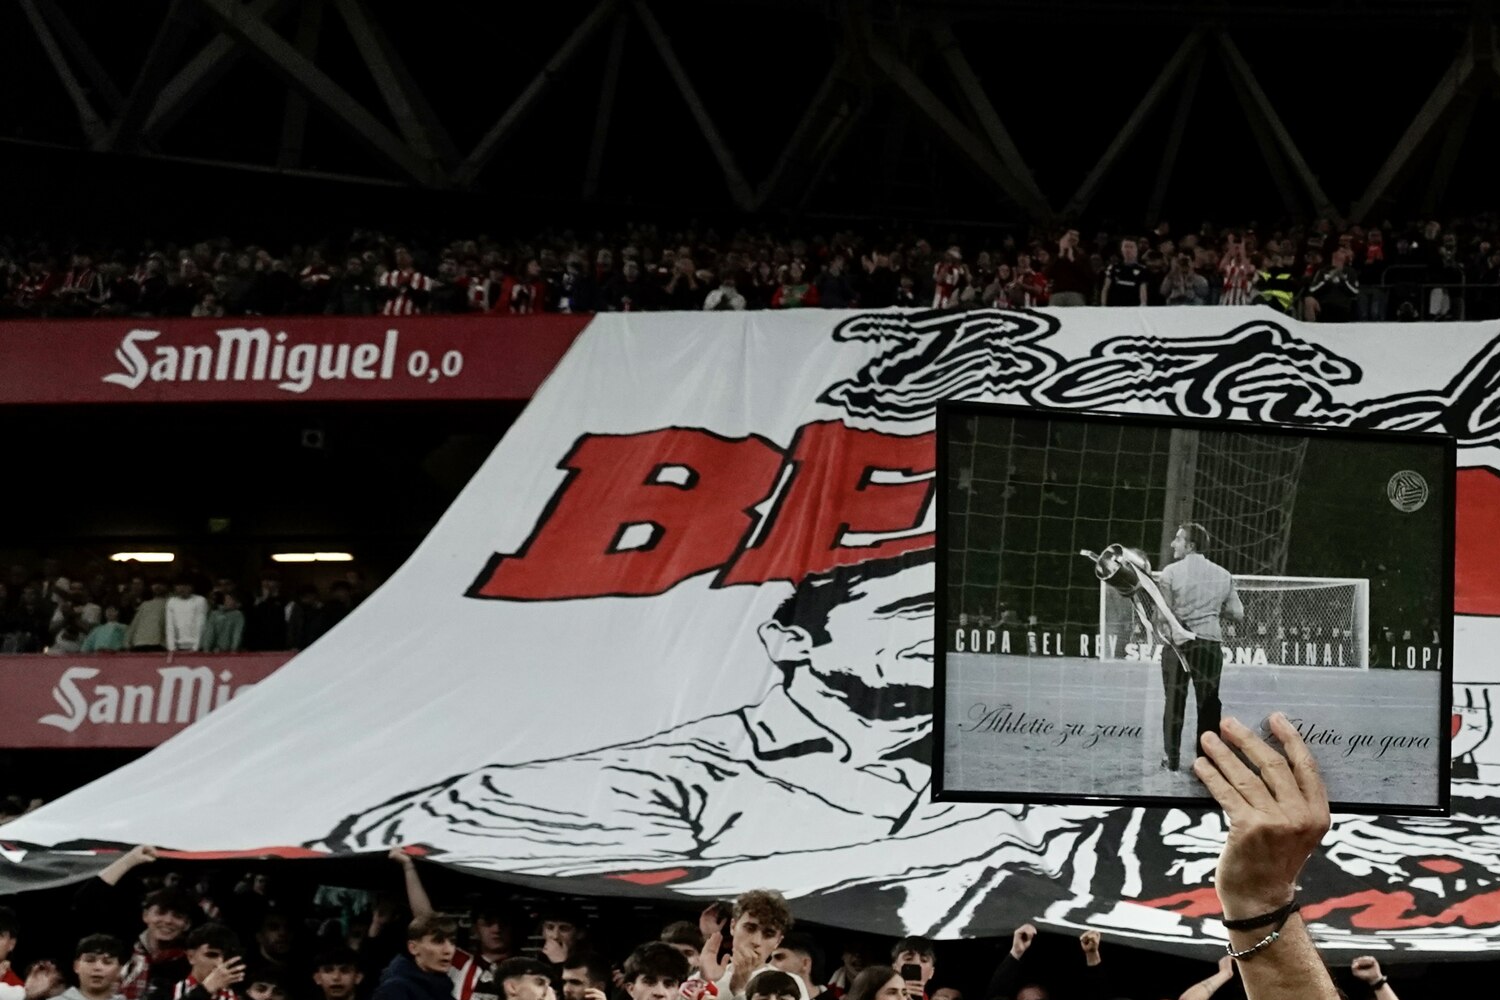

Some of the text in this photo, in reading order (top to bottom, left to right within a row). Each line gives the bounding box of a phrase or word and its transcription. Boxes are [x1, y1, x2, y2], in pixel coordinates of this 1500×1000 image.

[102, 327, 399, 393] SanMiguel
[955, 628, 1011, 653] COPA
[1281, 641, 1346, 667] FINAL
[38, 665, 260, 733] SanMi
[958, 702, 1145, 749] Athletic zu zara
[1342, 734, 1374, 759] gu
[1376, 734, 1434, 760] gara
